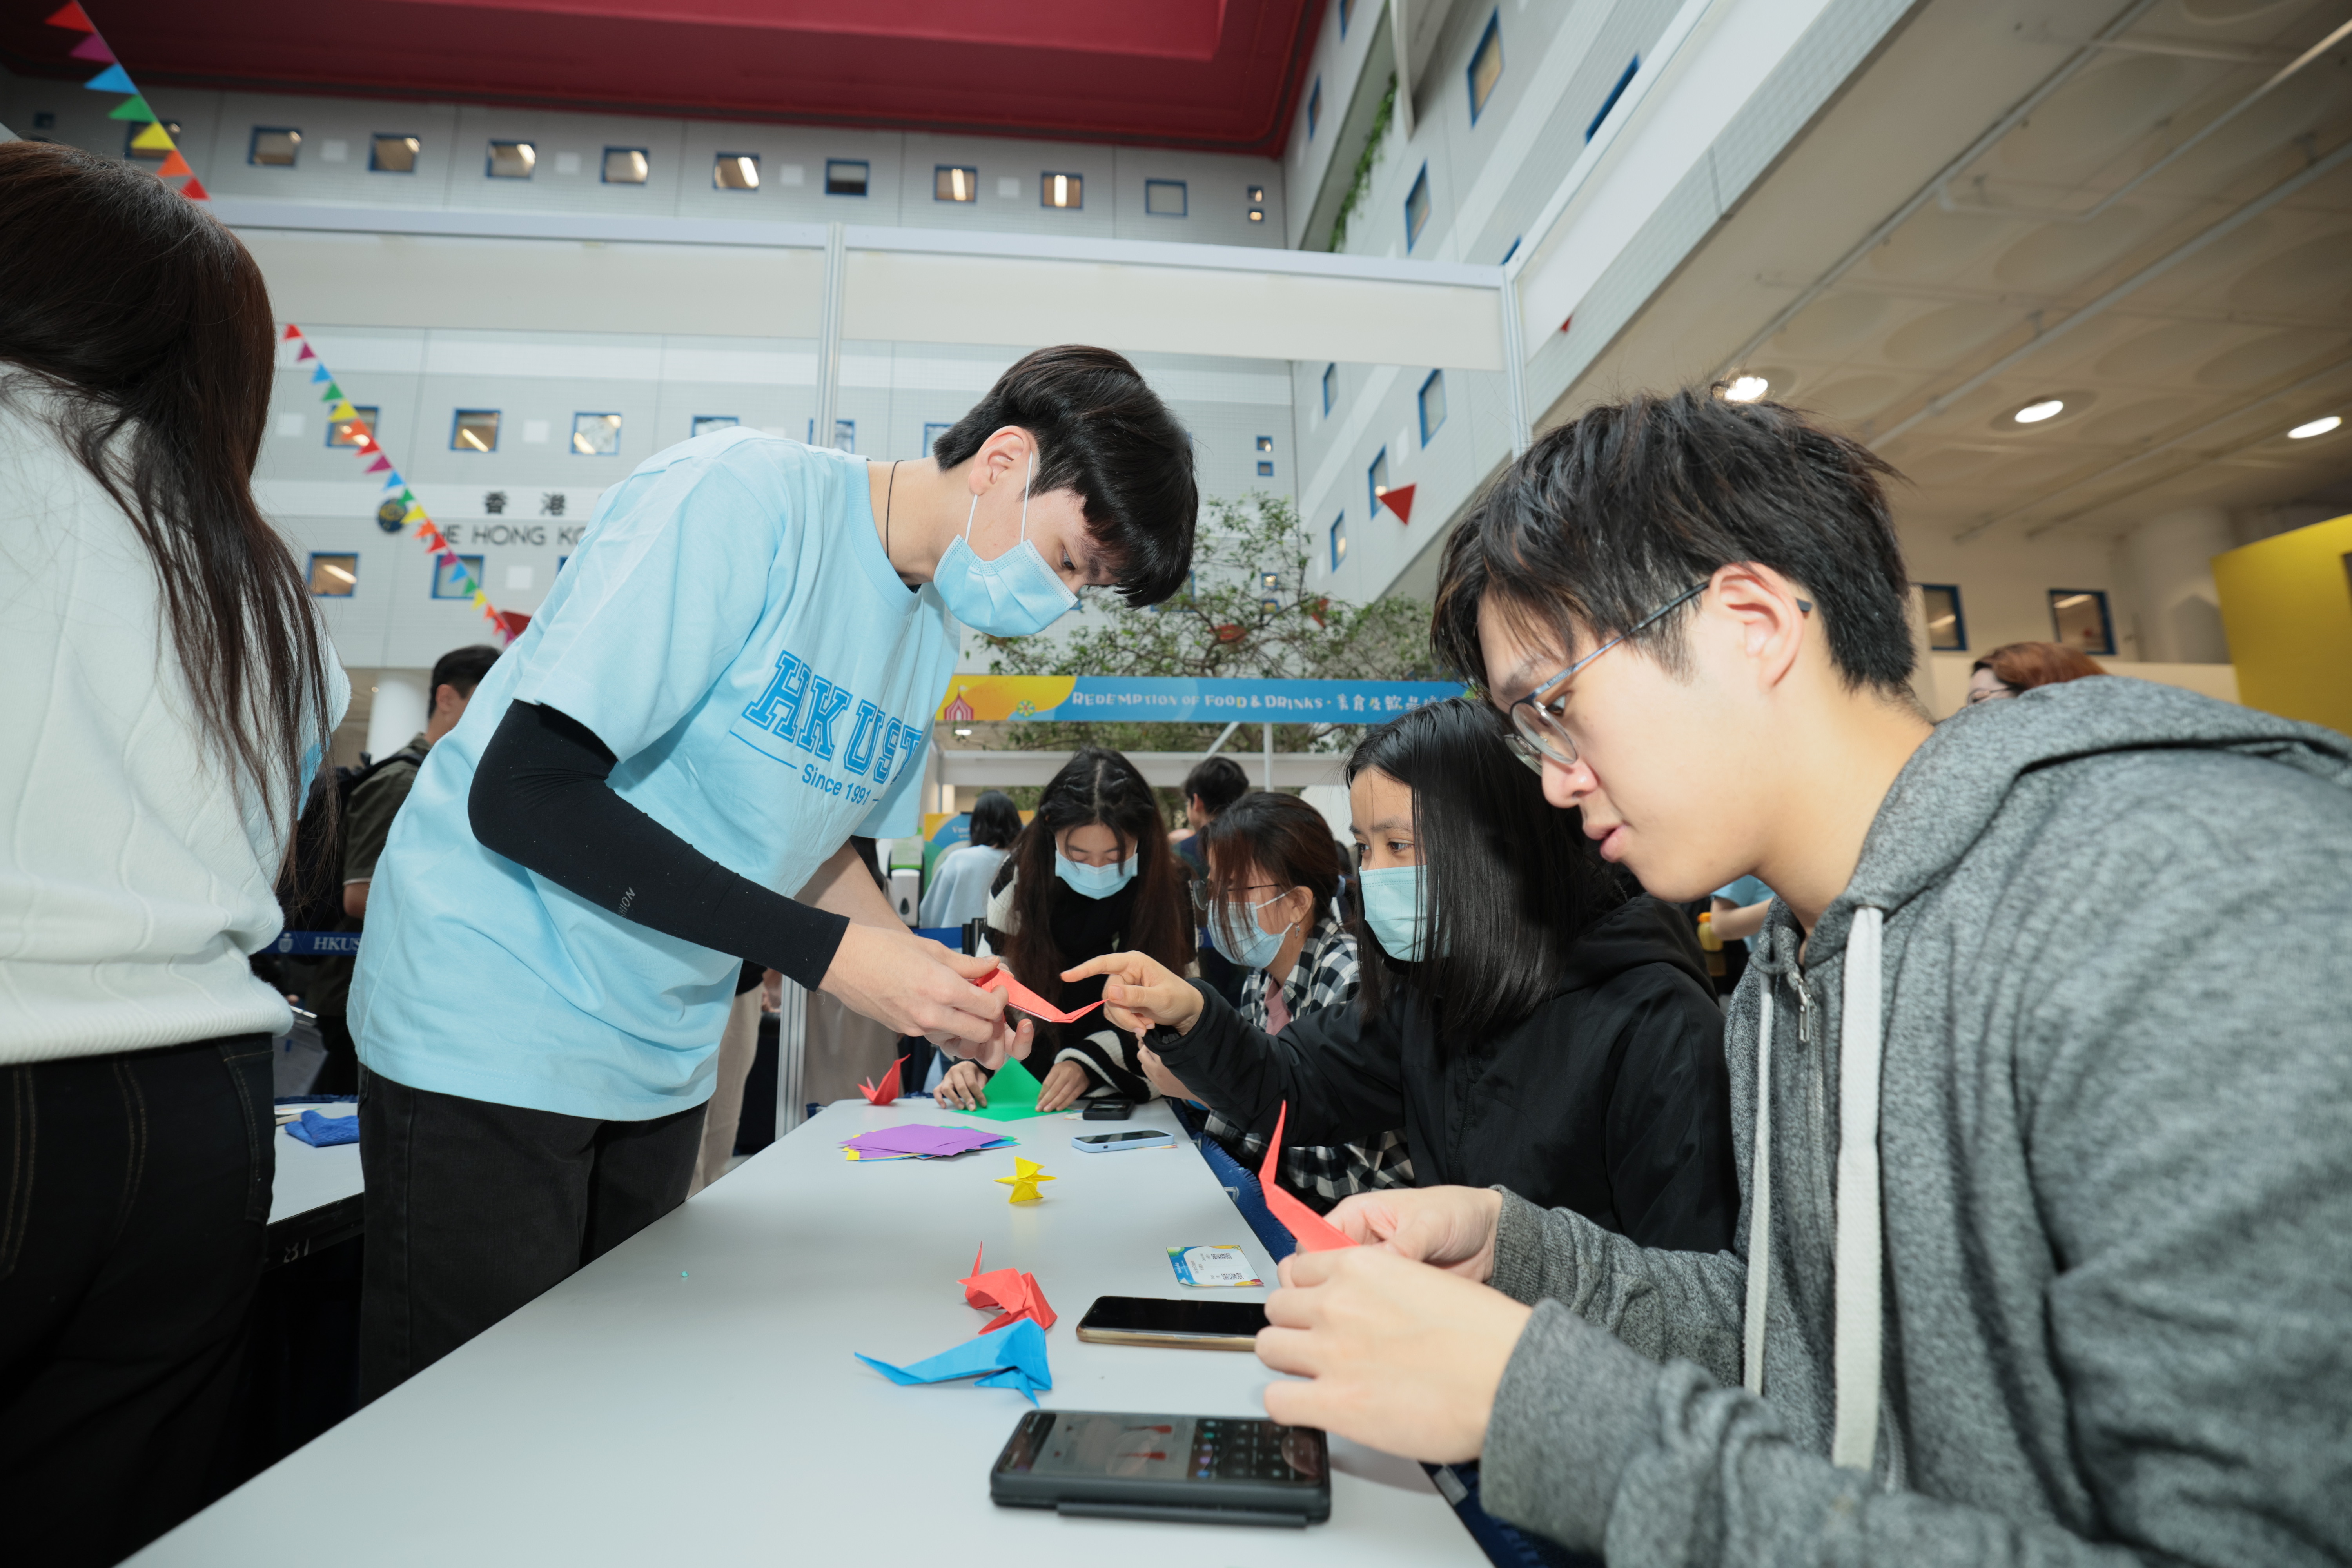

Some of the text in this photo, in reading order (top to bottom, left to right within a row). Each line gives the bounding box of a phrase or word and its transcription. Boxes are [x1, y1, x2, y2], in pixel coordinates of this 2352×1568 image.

[472, 524, 546, 546] HONG
[1073, 691, 1323, 710] REDEMPTION OF FOOD & DRINKS
[742, 650, 923, 785] HKUST
[802, 763, 871, 805] Since 1991
